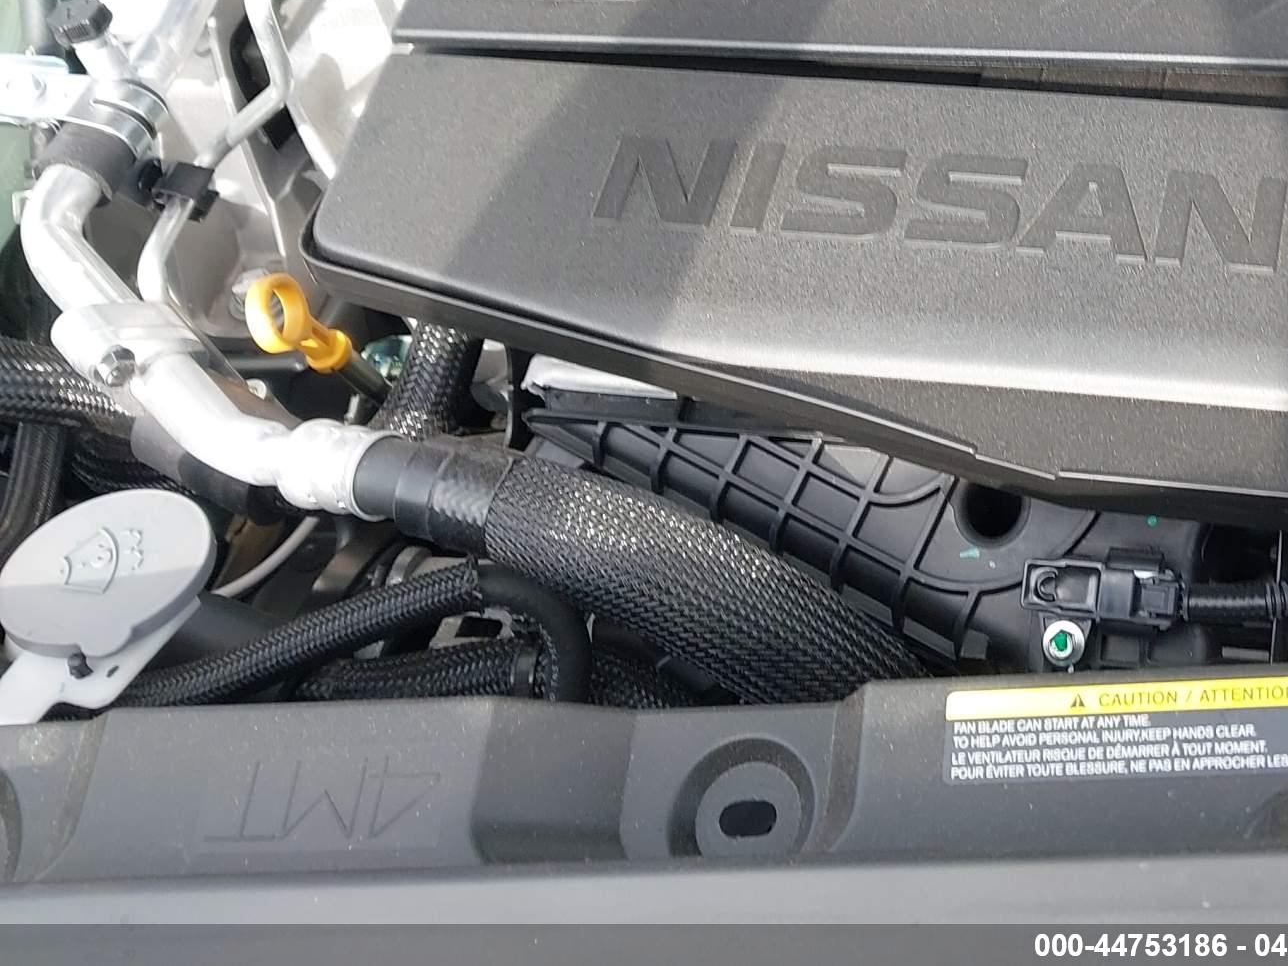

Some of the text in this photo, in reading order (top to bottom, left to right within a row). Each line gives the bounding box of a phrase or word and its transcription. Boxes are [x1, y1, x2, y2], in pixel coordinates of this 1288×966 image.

[592, 137, 1288, 275] NISSAN
[1099, 690, 1178, 707] CAUTION
[1185, 690, 1192, 703] /
[953, 713, 1151, 735] FAN BLADE CAN START AT ANY TIME.
[953, 735, 969, 749] TO
[971, 734, 1001, 748] HELP
[1002, 732, 1037, 747] AVOID
[1038, 730, 1099, 746] PERSONAL
[1172, 725, 1214, 740] HANDS
[1216, 724, 1257, 738] CLEAR.
[952, 739, 1267, 766] LE VENTILATEUR RISQUE DE DÉMARRER À TOUT MOMENT.
[951, 765, 983, 780] POUR
[986, 762, 1024, 778] ÉVITER
[1026, 763, 1064, 777] TOUTE
[1065, 760, 1128, 776] BLESSURE,
[1130, 759, 1148, 773] NE
[1149, 758, 1172, 772] PAS
[1174, 757, 1191, 771] EN
[1192, 755, 1265, 771] APPROCHER
